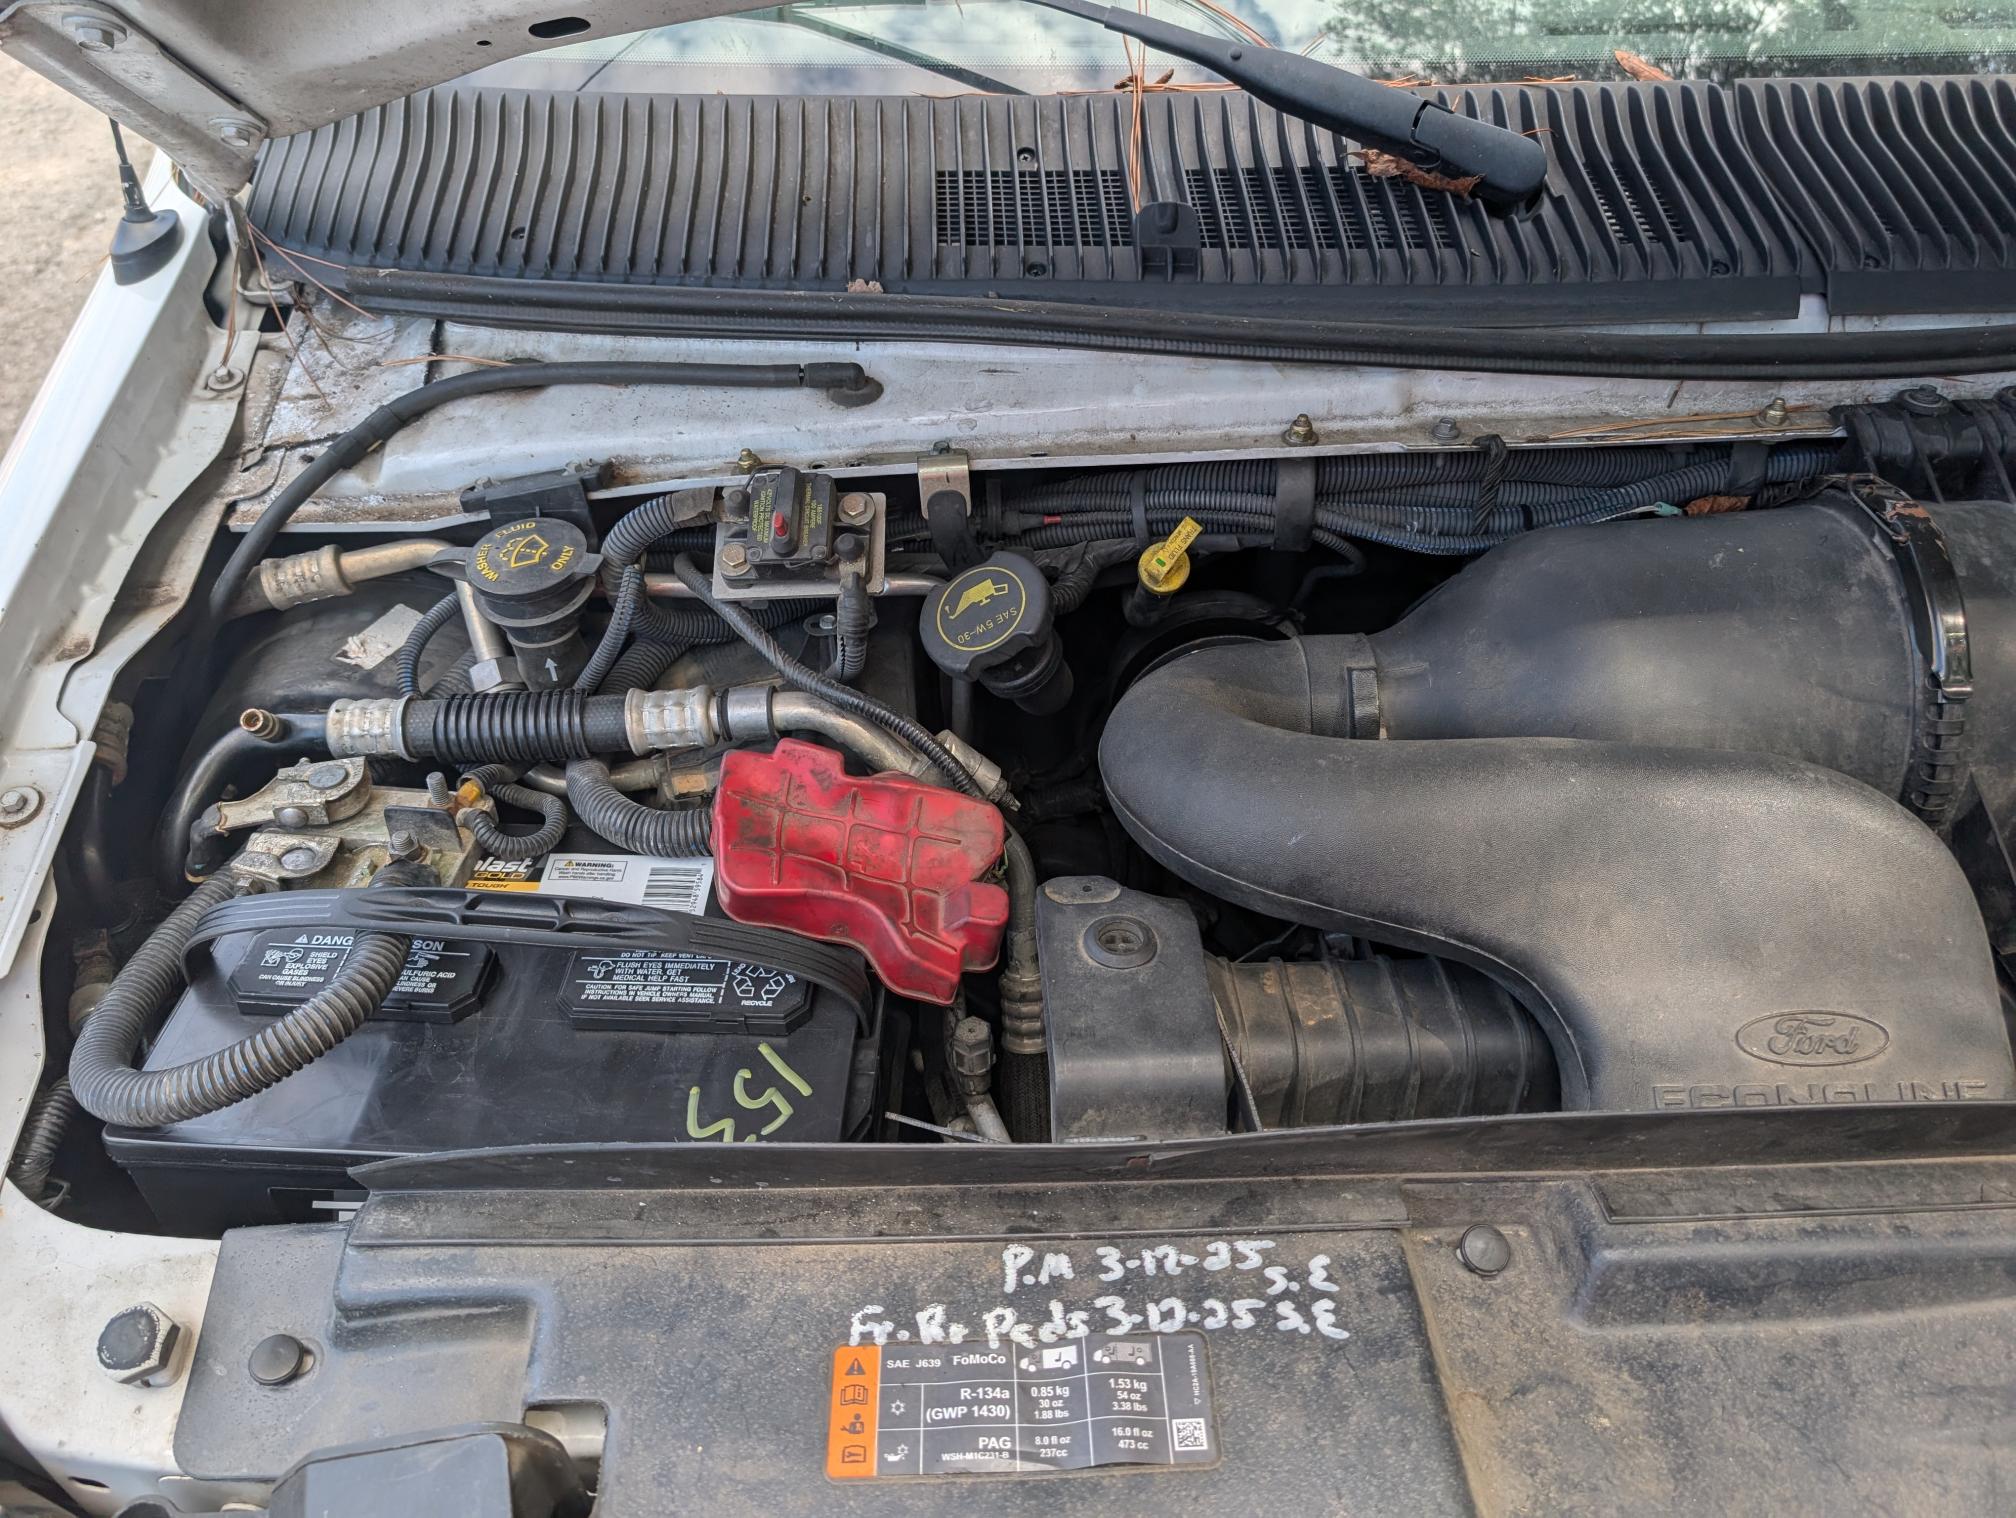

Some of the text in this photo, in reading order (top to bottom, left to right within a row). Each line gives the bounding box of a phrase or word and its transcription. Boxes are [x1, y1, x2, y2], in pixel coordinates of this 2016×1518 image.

[476, 522, 536, 582] WASHER FLUID
[550, 545, 576, 570] ONLY
[1168, 544, 1184, 560] FLUID
[957, 607, 1017, 644] SAE 5W-30
[412, 940, 446, 951] SON
[731, 963, 746, 975] LEAD
[1767, 1016, 1858, 1055] Ford
[886, 1353, 1006, 1368] SAE J639 FoMoCo
[1108, 1378, 1147, 1392] 1.53 kg
[960, 1387, 1010, 1400] R-134a
[1031, 1386, 1070, 1398] 0.85 kg
[1116, 1391, 1128, 1399] 54
[1039, 1400, 1050, 1408] 30
[1112, 1402, 1148, 1412] 3.38 lbs
[926, 1405, 1010, 1422] (GWP 1430)
[1034, 1409, 1069, 1419] 1.88 lbs
[1112, 1427, 1131, 1436] 16.0
[1133, 1428, 1139, 1436] fl
[978, 1436, 1012, 1449] PAG
[1034, 1436, 1049, 1445] 8.0
[1051, 1436, 1058, 1444] fl
[1118, 1439, 1135, 1449] 473
[1039, 1448, 1068, 1458] 237cc
